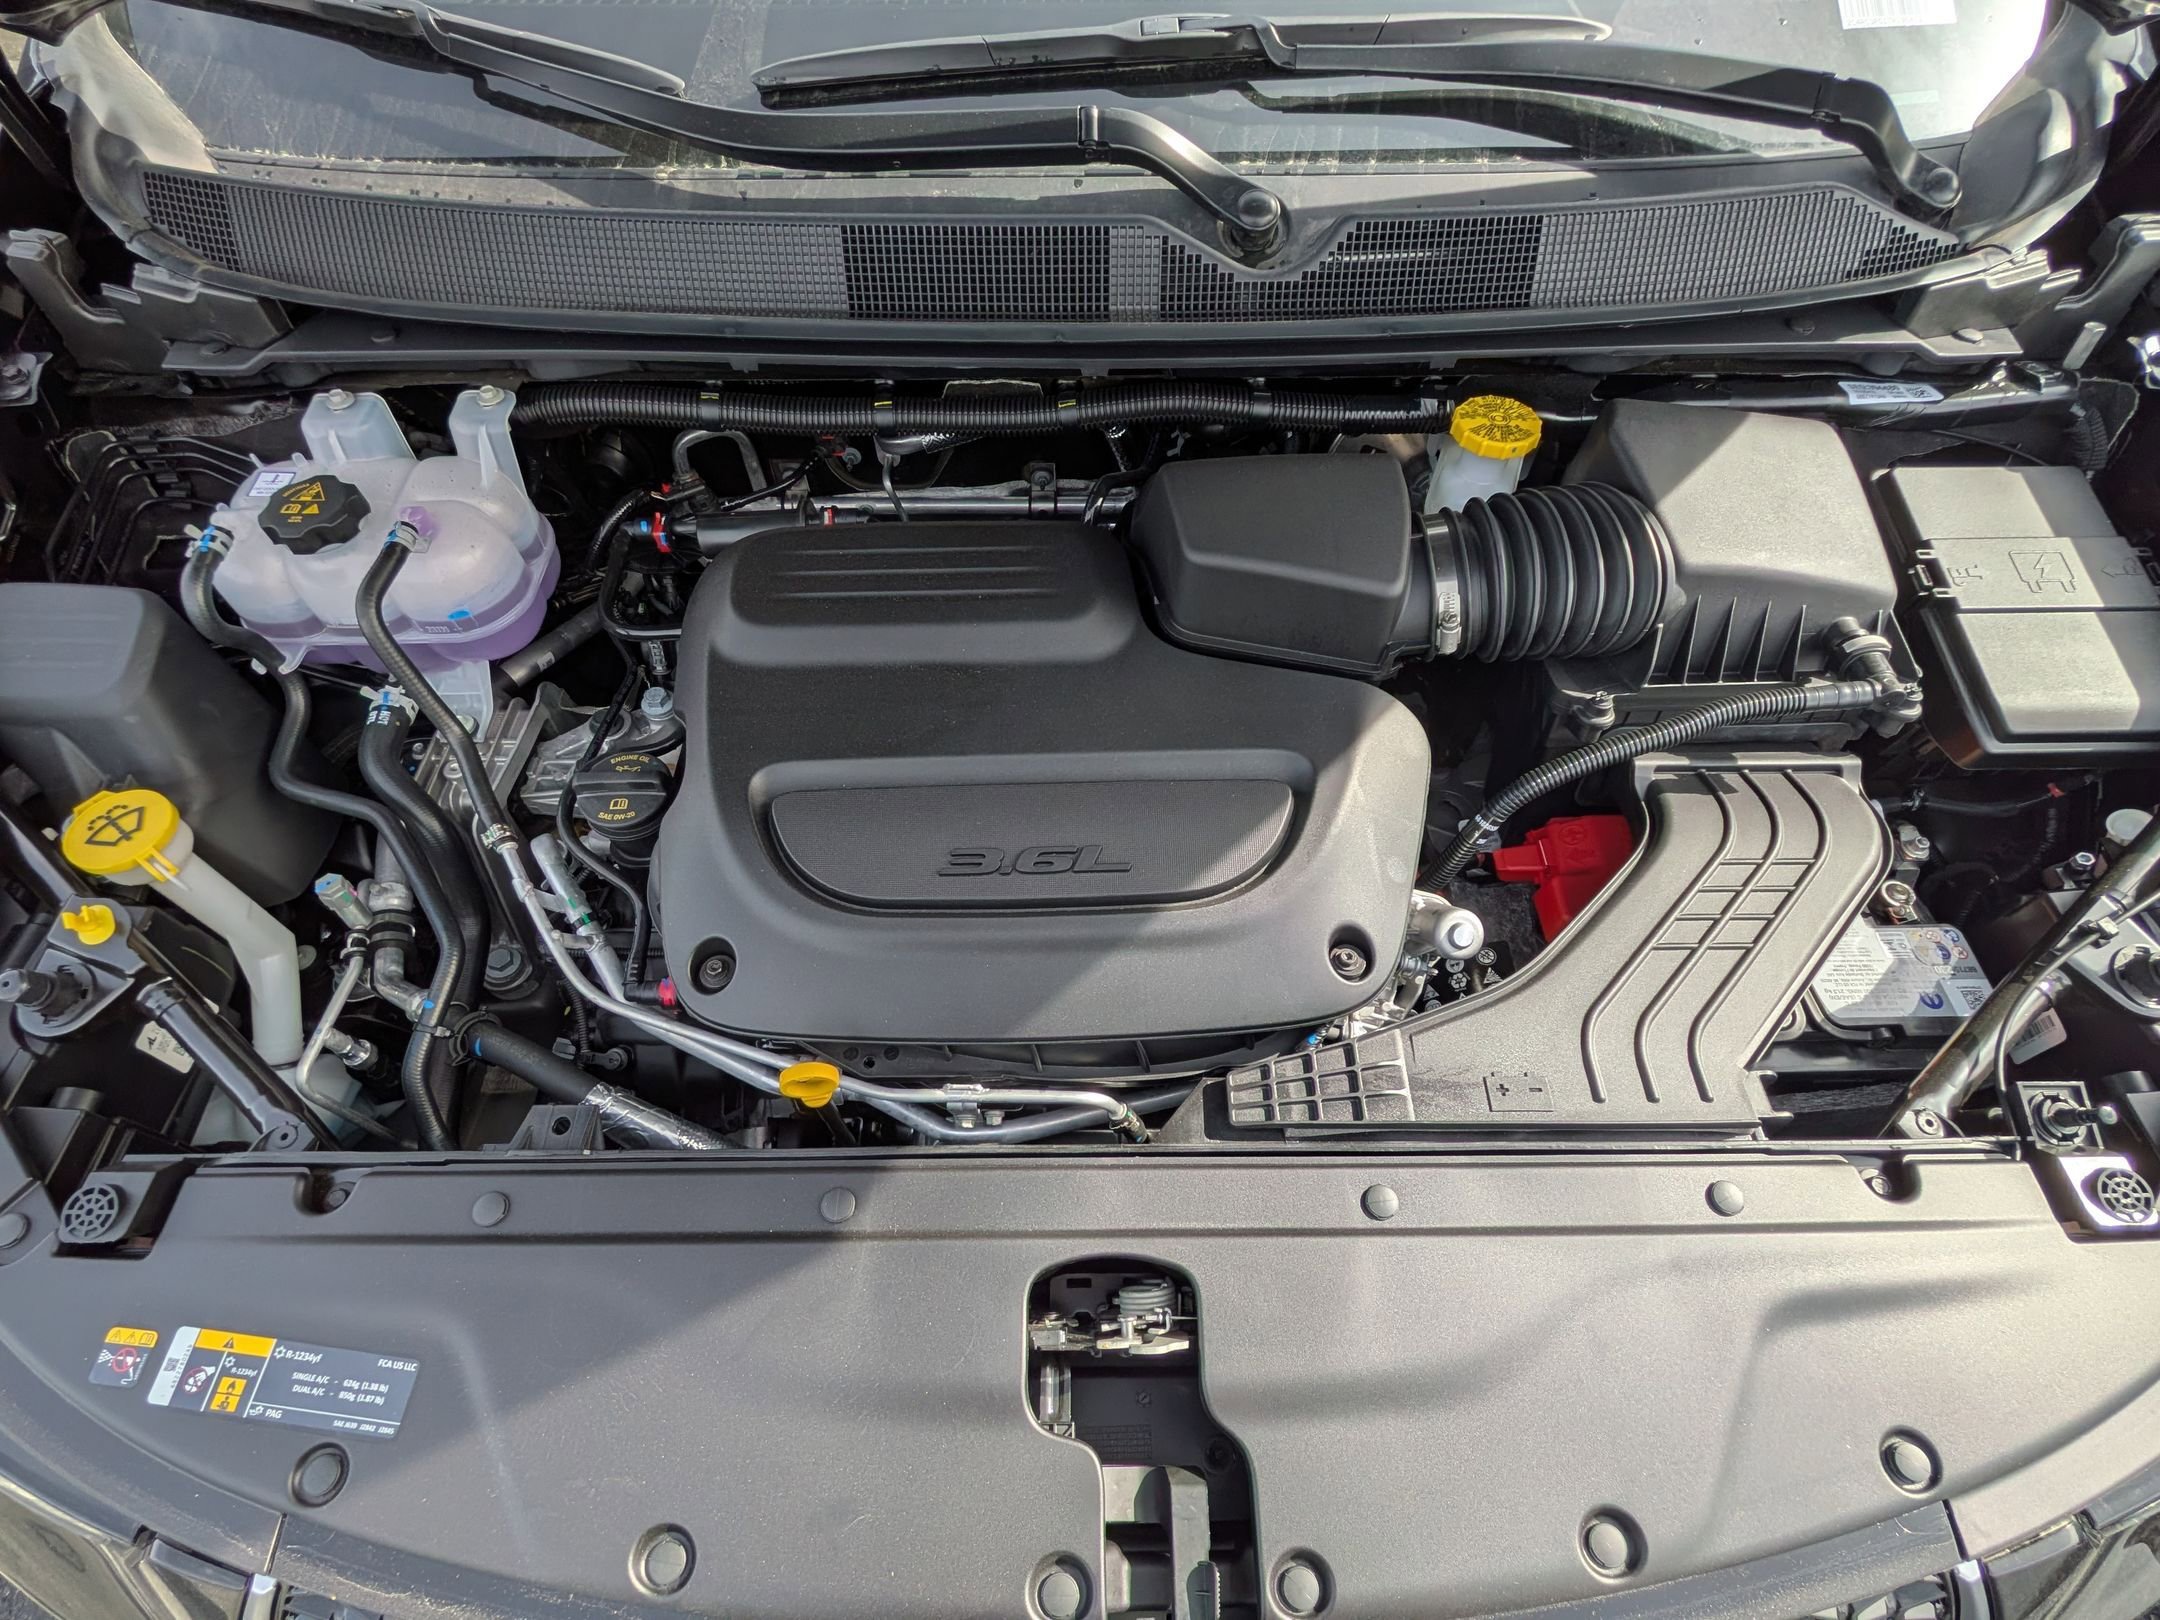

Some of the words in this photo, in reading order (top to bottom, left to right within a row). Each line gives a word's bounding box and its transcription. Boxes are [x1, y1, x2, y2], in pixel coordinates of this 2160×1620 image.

[610, 754, 639, 764] ENGINE
[639, 755, 651, 763] OIL
[598, 811, 612, 820] SAE
[613, 811, 636, 820] 0W-20
[938, 844, 1133, 877] 3.6L
[285, 1350, 323, 1365] R-1234yf
[377, 1359, 393, 1369] FCA
[393, 1361, 404, 1370] US
[404, 1362, 418, 1372] LLC
[292, 1371, 316, 1383] SINGLE
[315, 1375, 330, 1385] A/C
[292, 1384, 312, 1394] DUAL
[311, 1387, 326, 1397] A/C
[265, 1408, 282, 1419] PAG
